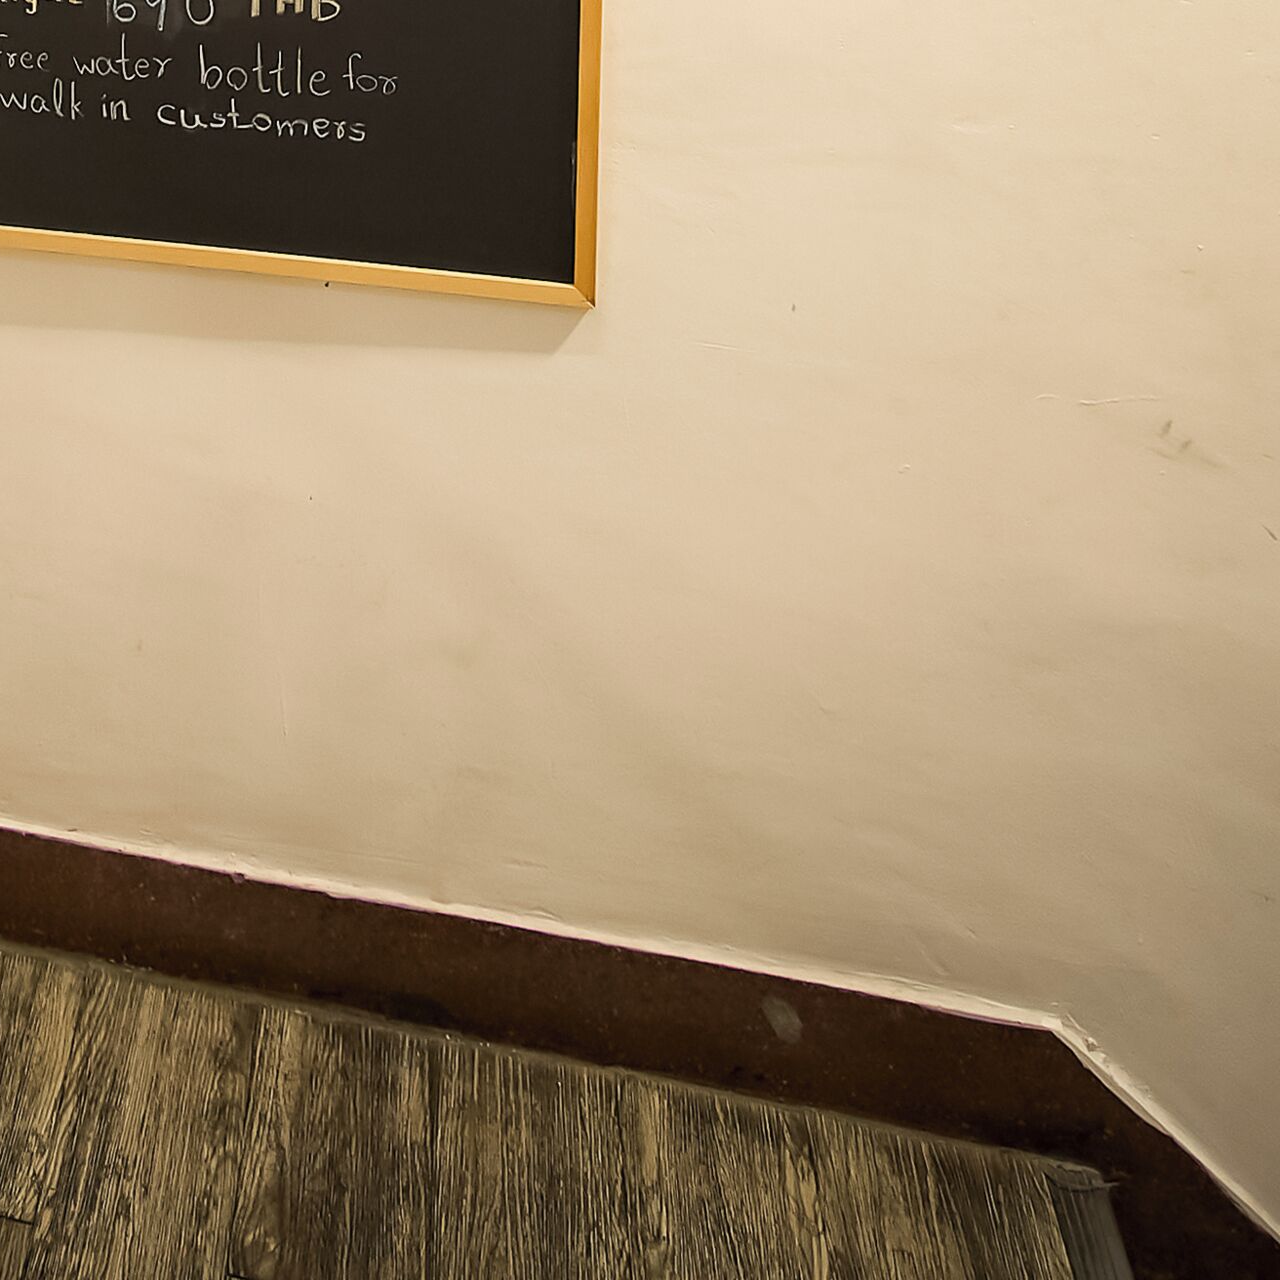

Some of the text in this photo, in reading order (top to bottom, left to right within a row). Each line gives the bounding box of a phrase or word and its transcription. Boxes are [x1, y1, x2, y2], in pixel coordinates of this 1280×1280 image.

[73, 33, 173, 81] water
[199, 43, 331, 98] bottle
[342, 52, 400, 96] for
[0, 78, 366, 142] walk in customers
